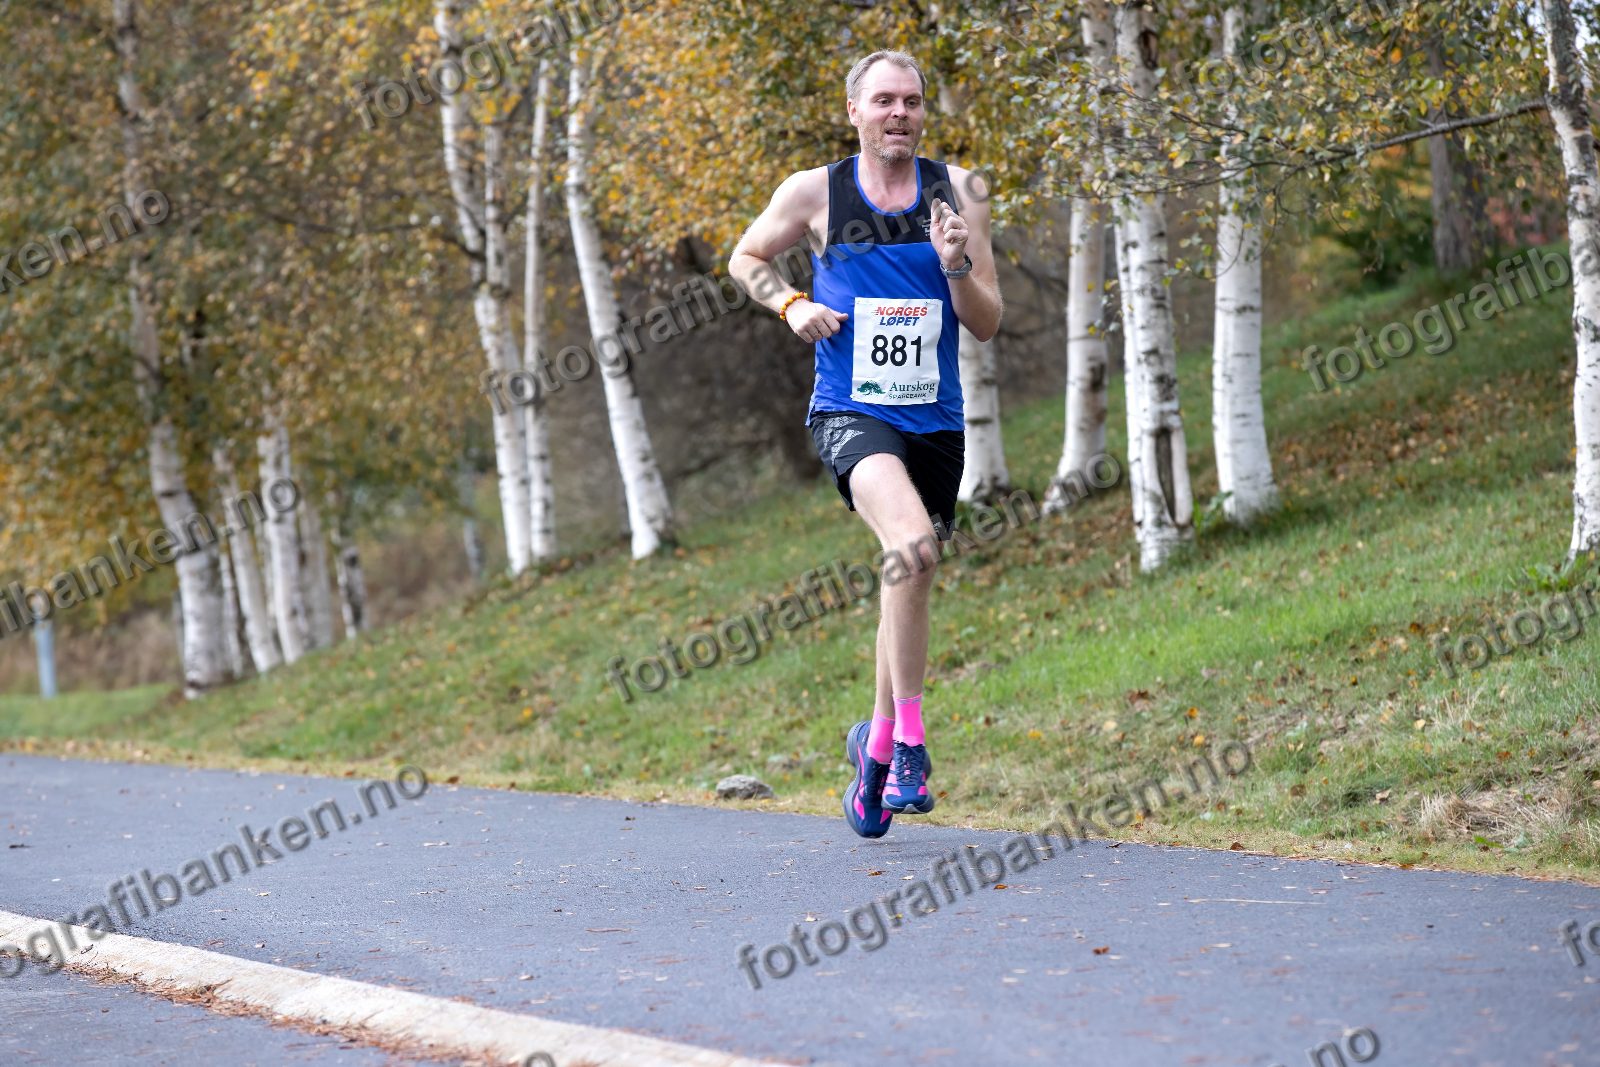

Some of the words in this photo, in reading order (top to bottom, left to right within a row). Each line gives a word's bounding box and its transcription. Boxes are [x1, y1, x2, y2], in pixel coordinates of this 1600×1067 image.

[877, 307, 928, 316] NORGES
[879, 316, 920, 326] LØPET
[871, 334, 922, 367] 881
[889, 380, 936, 394] Aurskog
